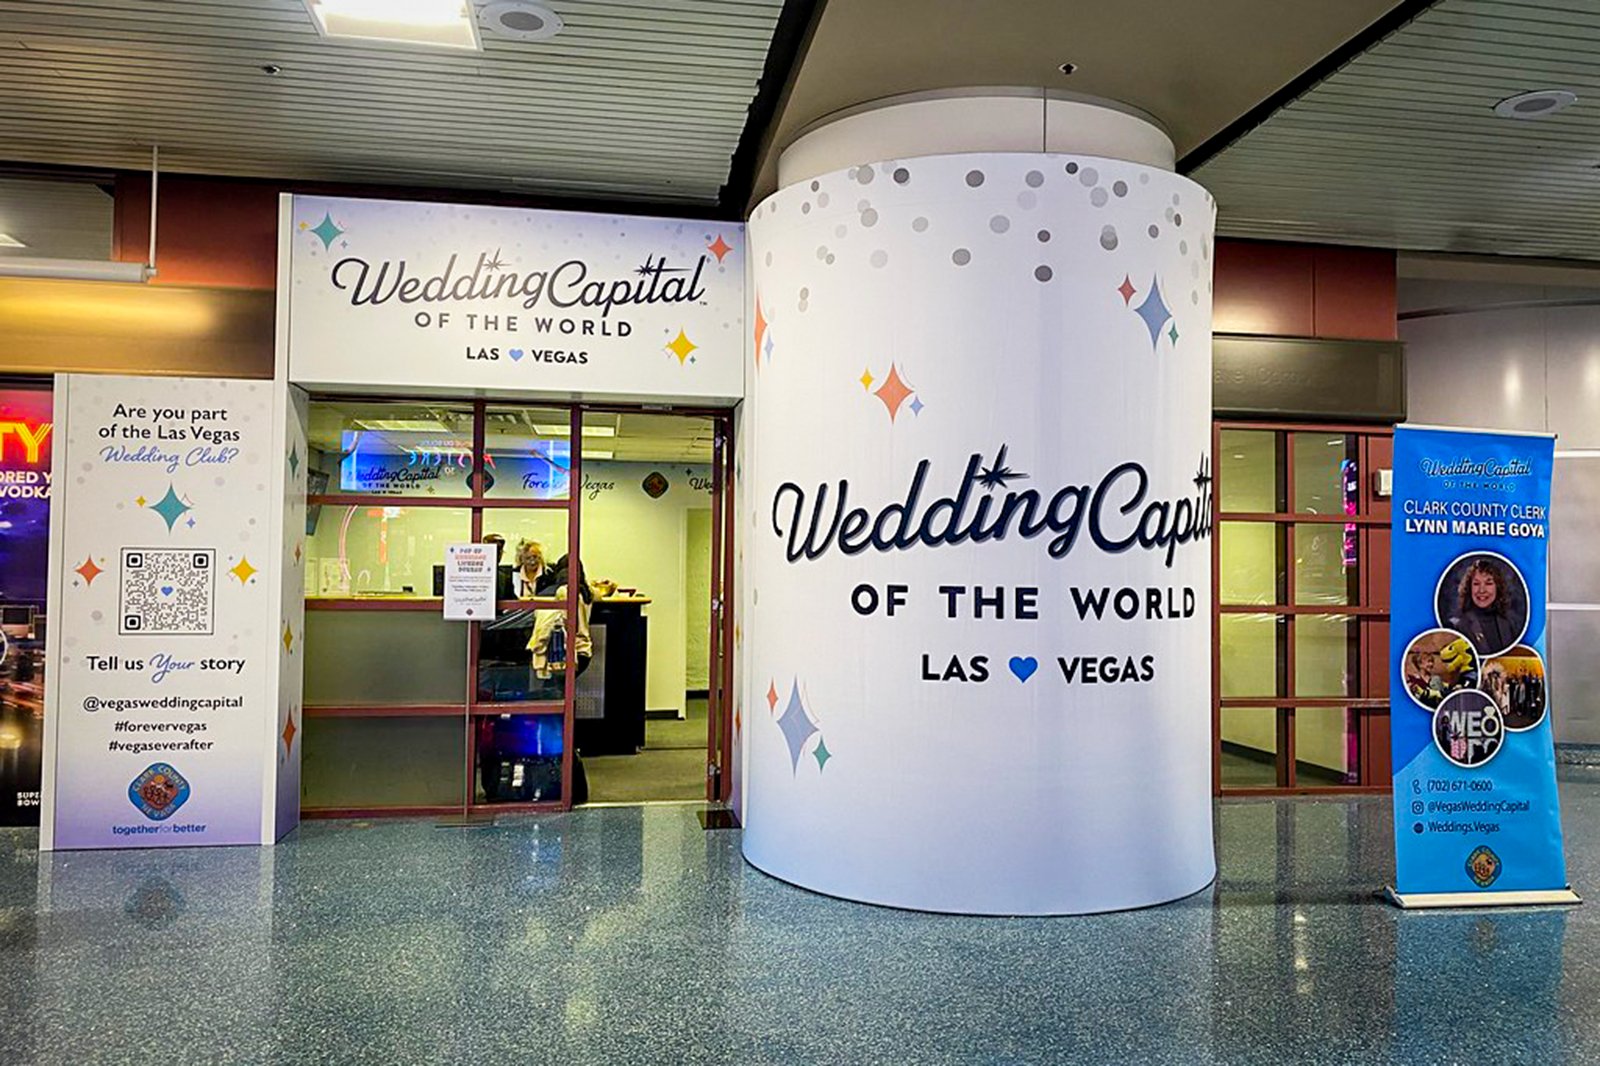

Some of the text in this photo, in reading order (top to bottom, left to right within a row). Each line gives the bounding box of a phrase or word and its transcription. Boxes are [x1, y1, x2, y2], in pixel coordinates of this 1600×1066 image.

[414, 311, 632, 337] OF THE WORLD
[466, 346, 588, 364] LAS VEGAS
[112, 403, 228, 424] Are you part
[98, 424, 240, 445] of the Las Vegas
[99, 445, 239, 473] Wedding Club?
[1404, 500, 1546, 520] CLARK COUNTY CLERK
[1405, 519, 1545, 538] LYNN MARIE GOYA
[851, 583, 1196, 621] OF THE WORLD
[86, 653, 246, 684] Tell us Your story
[921, 654, 1154, 683] LAS VEGAS
[83, 696, 243, 712] @vegasweddingcapital
[114, 720, 207, 734] #forevervegas
[108, 739, 214, 754] #vegaseverafter
[1427, 779, 1493, 792] (702) 671-0600
[1427, 799, 1530, 815] @VegasWeddingCapital
[1427, 820, 1500, 835] Weddings.Vegas
